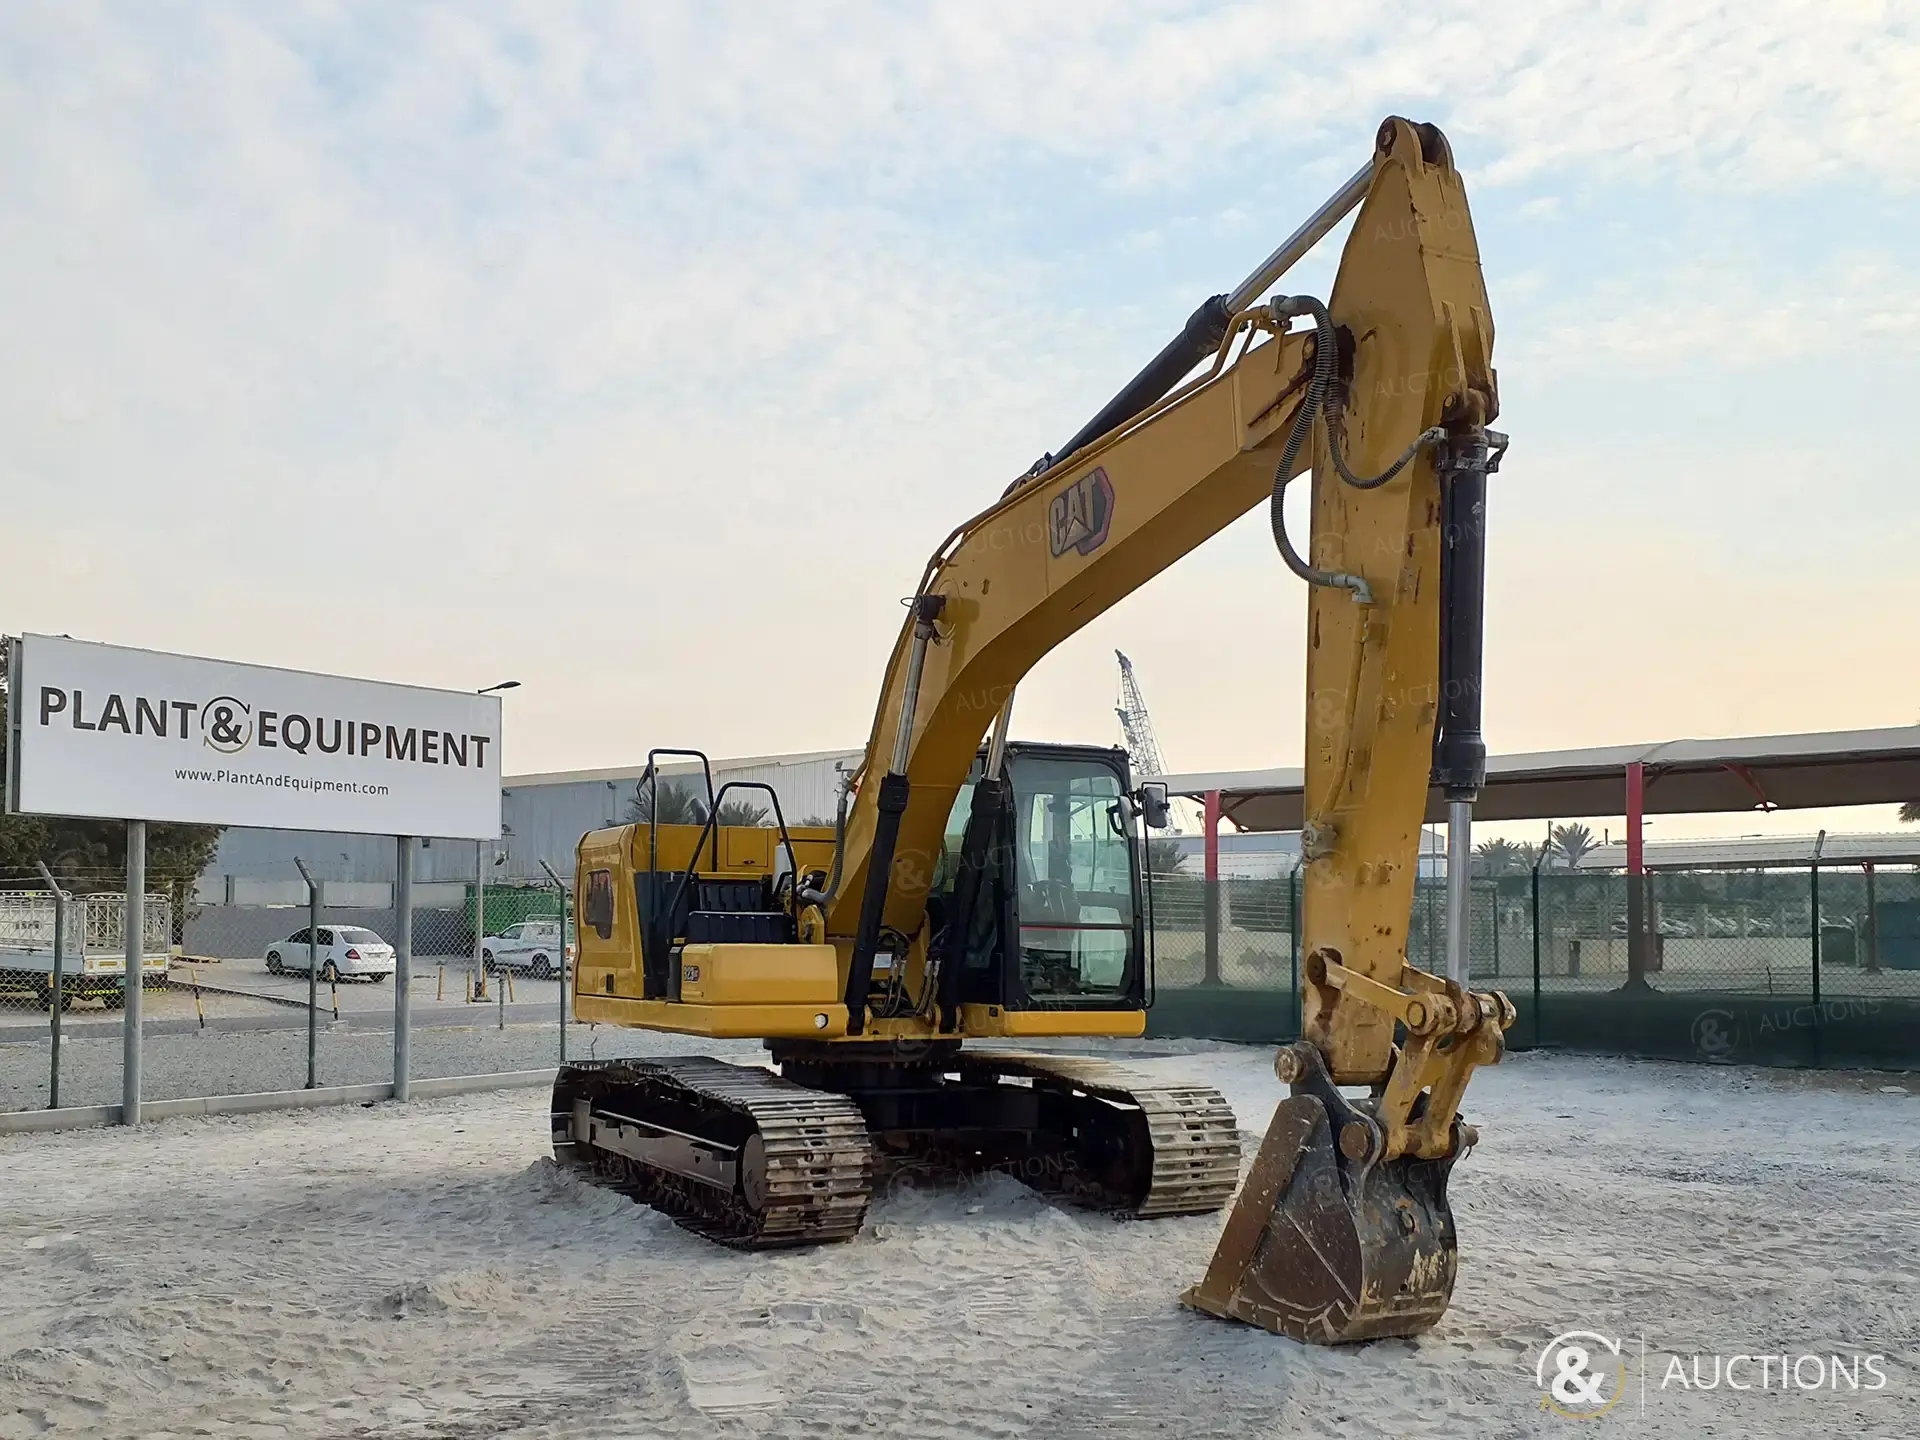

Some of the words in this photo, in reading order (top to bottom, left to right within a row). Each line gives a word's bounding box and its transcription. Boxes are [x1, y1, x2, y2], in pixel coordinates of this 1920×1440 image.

[1049, 473, 1096, 556] CAT
[40, 686, 198, 739] PLANT
[258, 711, 491, 768] EQUIPMENT
[175, 768, 389, 796] www.PlantAndEquipment.com
